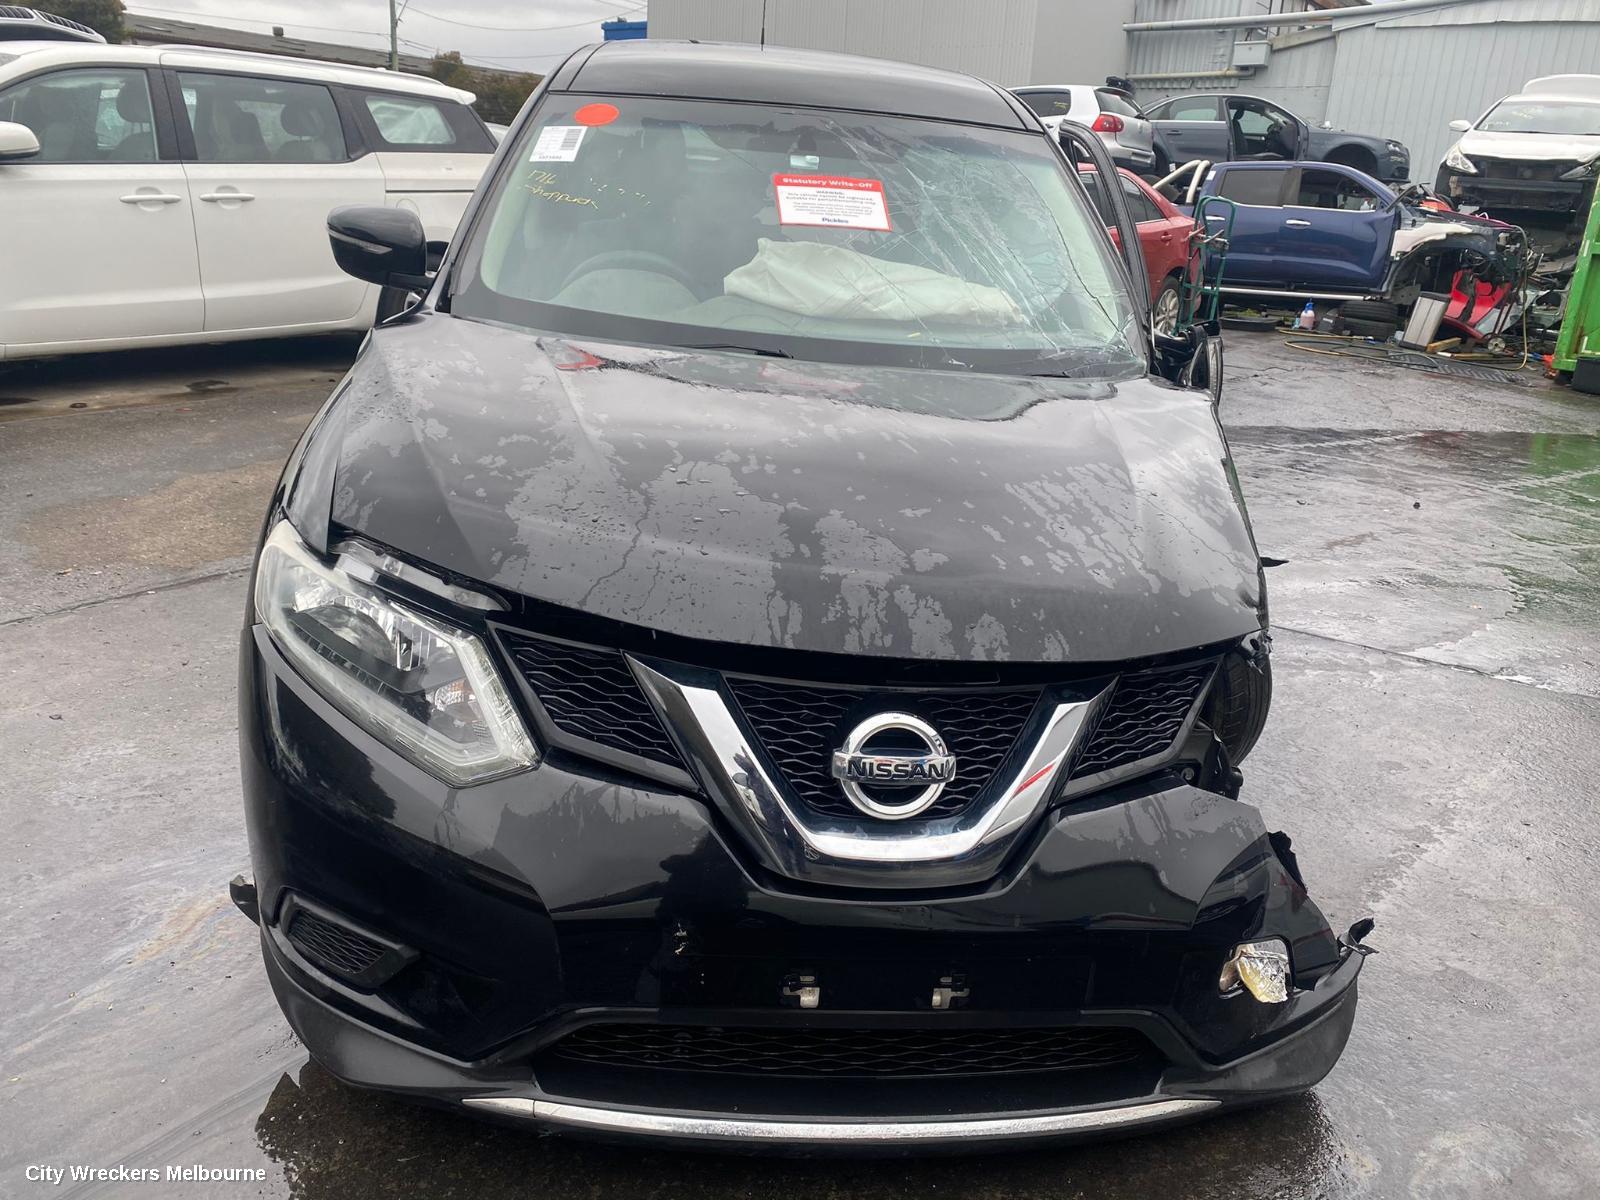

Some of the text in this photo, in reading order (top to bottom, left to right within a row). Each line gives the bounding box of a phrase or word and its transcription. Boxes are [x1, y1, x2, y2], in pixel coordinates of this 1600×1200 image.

[782, 177, 873, 188] Statutory Write-Off
[847, 757, 944, 780] NISSAN
